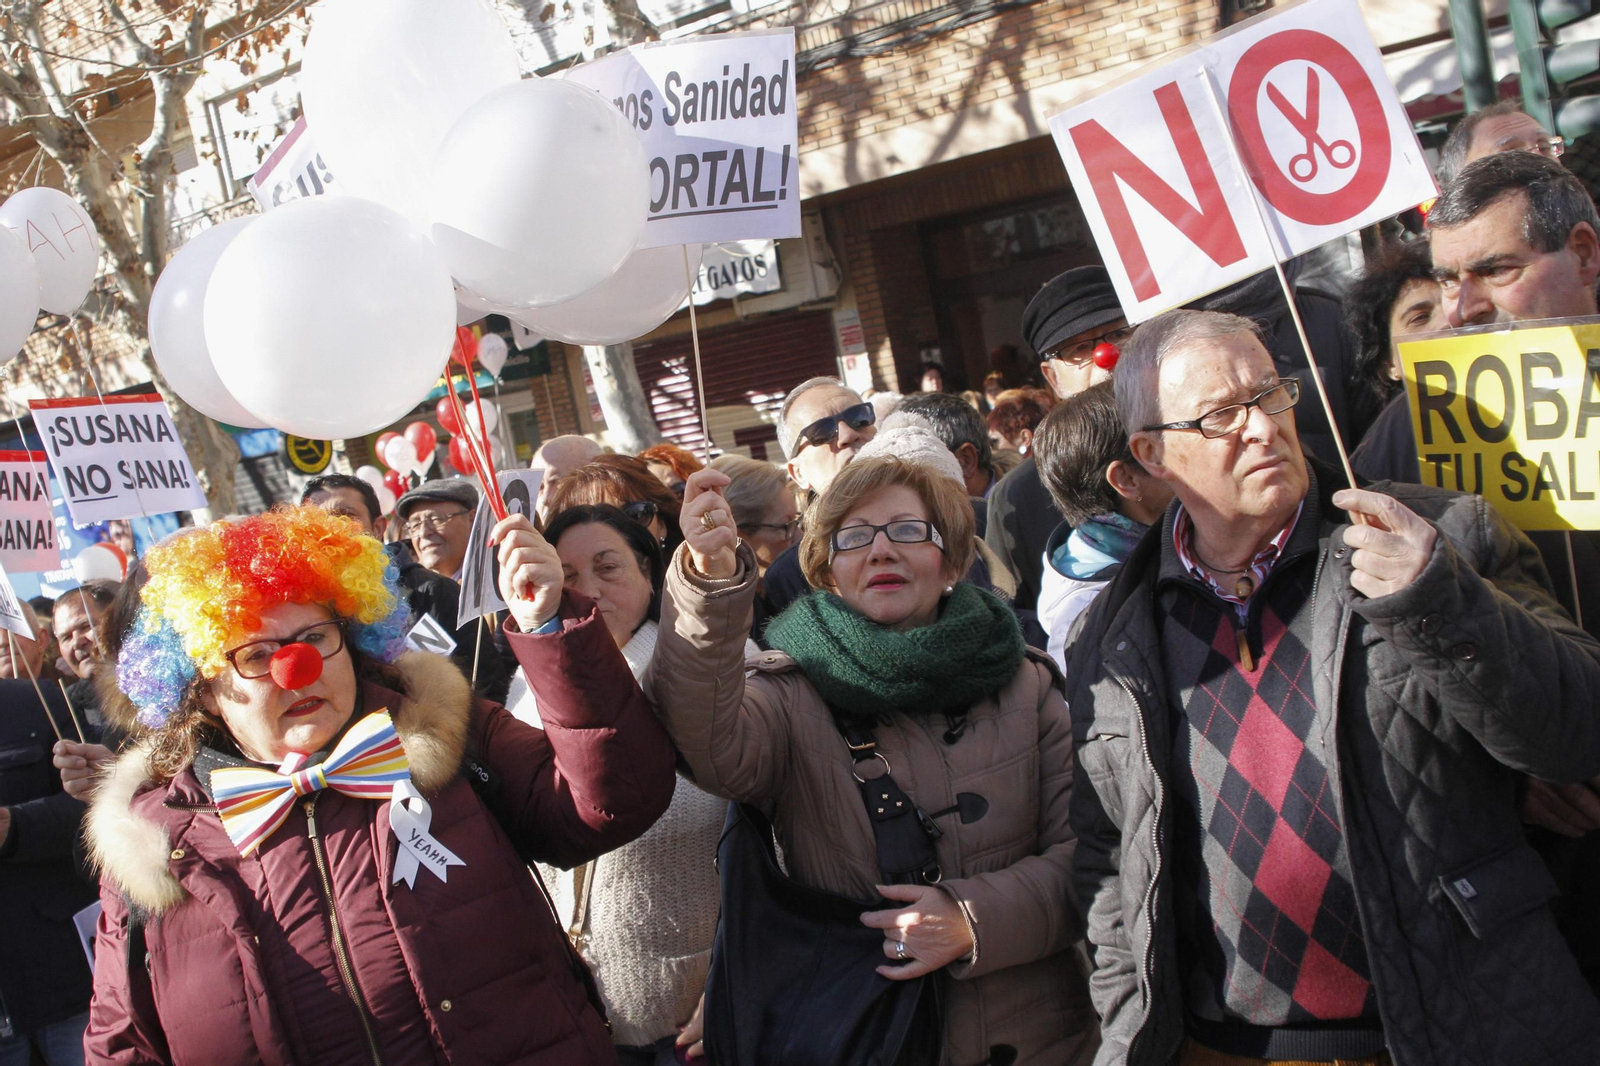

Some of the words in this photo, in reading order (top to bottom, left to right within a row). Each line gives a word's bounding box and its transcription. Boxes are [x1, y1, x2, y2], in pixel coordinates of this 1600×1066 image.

[662, 59, 789, 127] Sanidad
[649, 144, 791, 213] ORTAL!
[1069, 29, 1391, 303] NO
[10, 204, 95, 260] AH
[692, 253, 768, 295] EGALOS
[48, 413, 175, 457] ¡SUSANA
[0, 470, 49, 501] ANA
[63, 463, 112, 498] NO
[119, 459, 191, 491] SANA!
[1426, 453, 1483, 495] TU
[1501, 451, 1600, 502] SAL
[0, 519, 53, 550] ANA!
